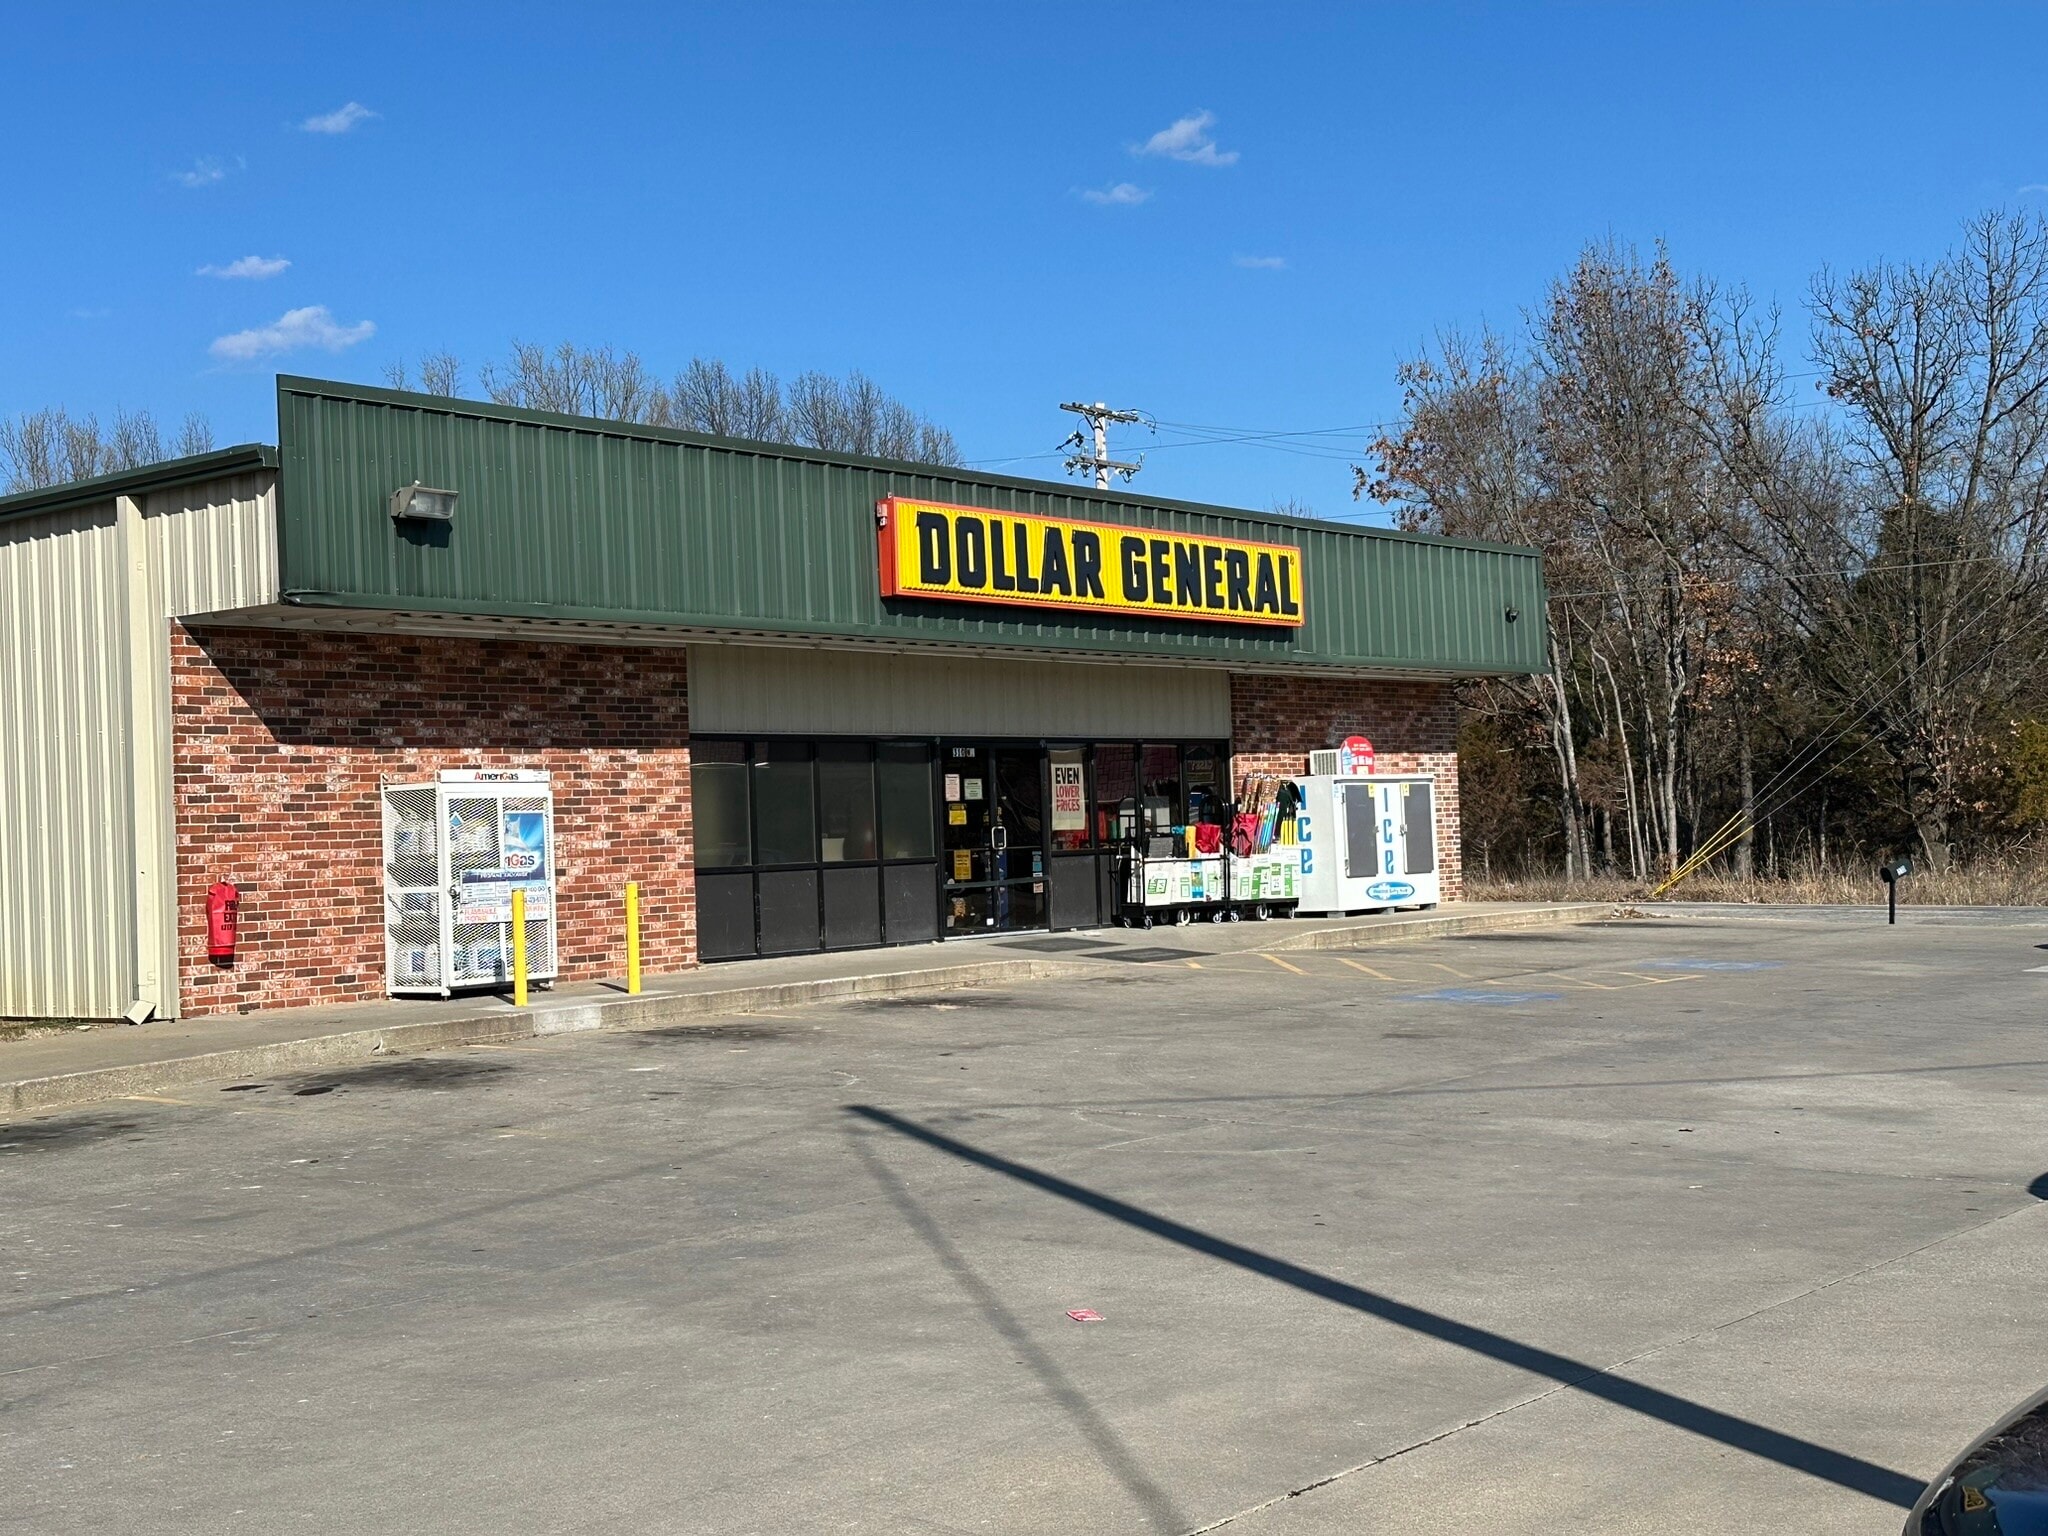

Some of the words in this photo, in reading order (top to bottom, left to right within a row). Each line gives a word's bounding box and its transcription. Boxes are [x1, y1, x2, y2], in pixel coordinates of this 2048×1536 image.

[916, 512, 1105, 599] DOLLAR
[1121, 536, 1299, 616] GENERAL
[474, 772, 519, 780] AmeriGas
[1055, 767, 1080, 784] EVEN
[1056, 785, 1080, 798] LOWER
[1056, 799, 1081, 812] PRICES
